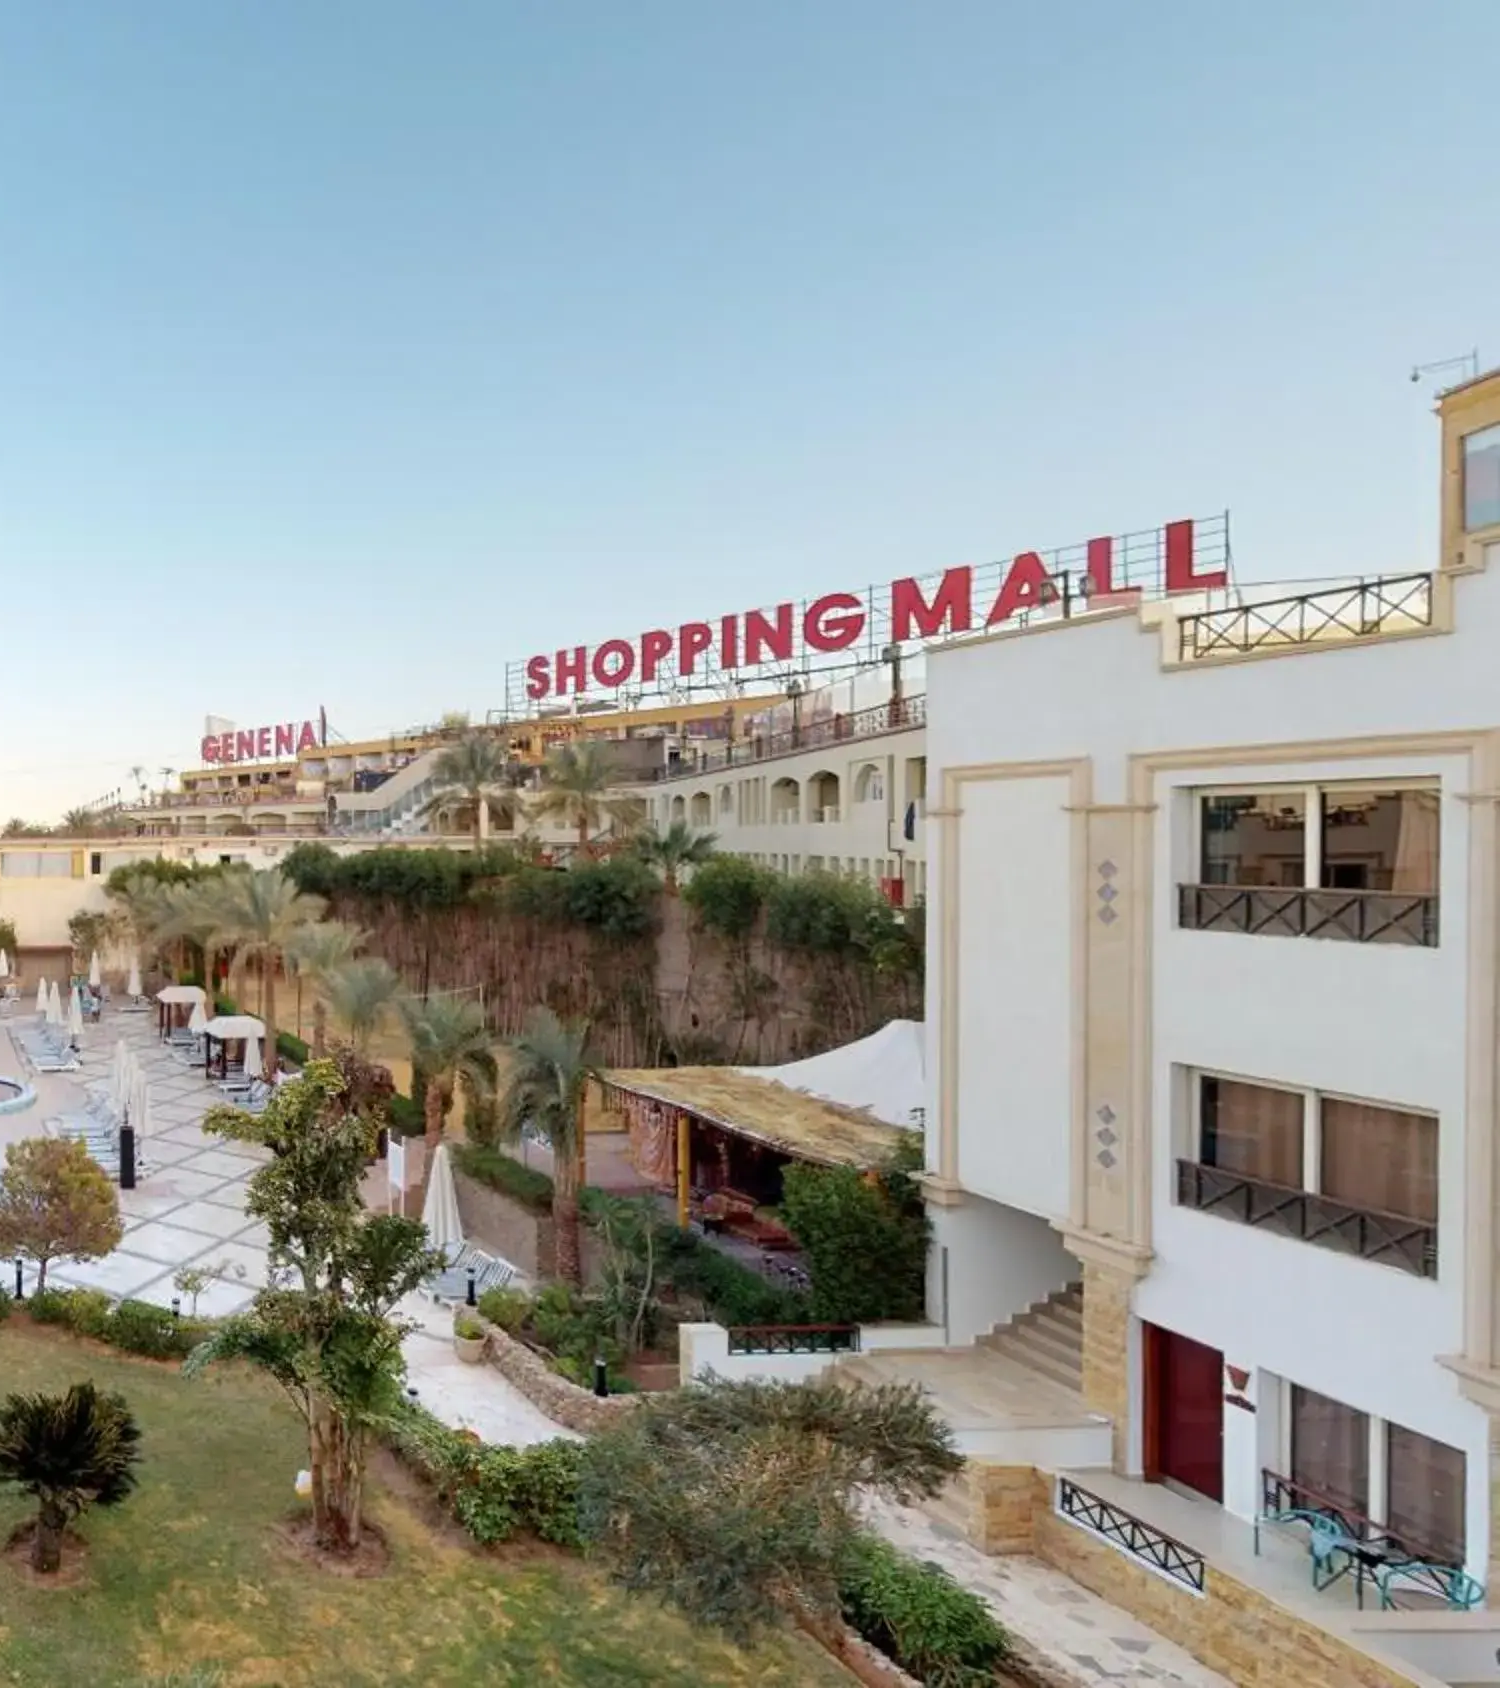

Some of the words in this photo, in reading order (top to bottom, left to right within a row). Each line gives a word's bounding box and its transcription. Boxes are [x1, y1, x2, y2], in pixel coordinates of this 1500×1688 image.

[526, 593, 866, 699] SHOPPING
[891, 519, 1227, 642] MALL
[201, 720, 317, 762] GENENA
